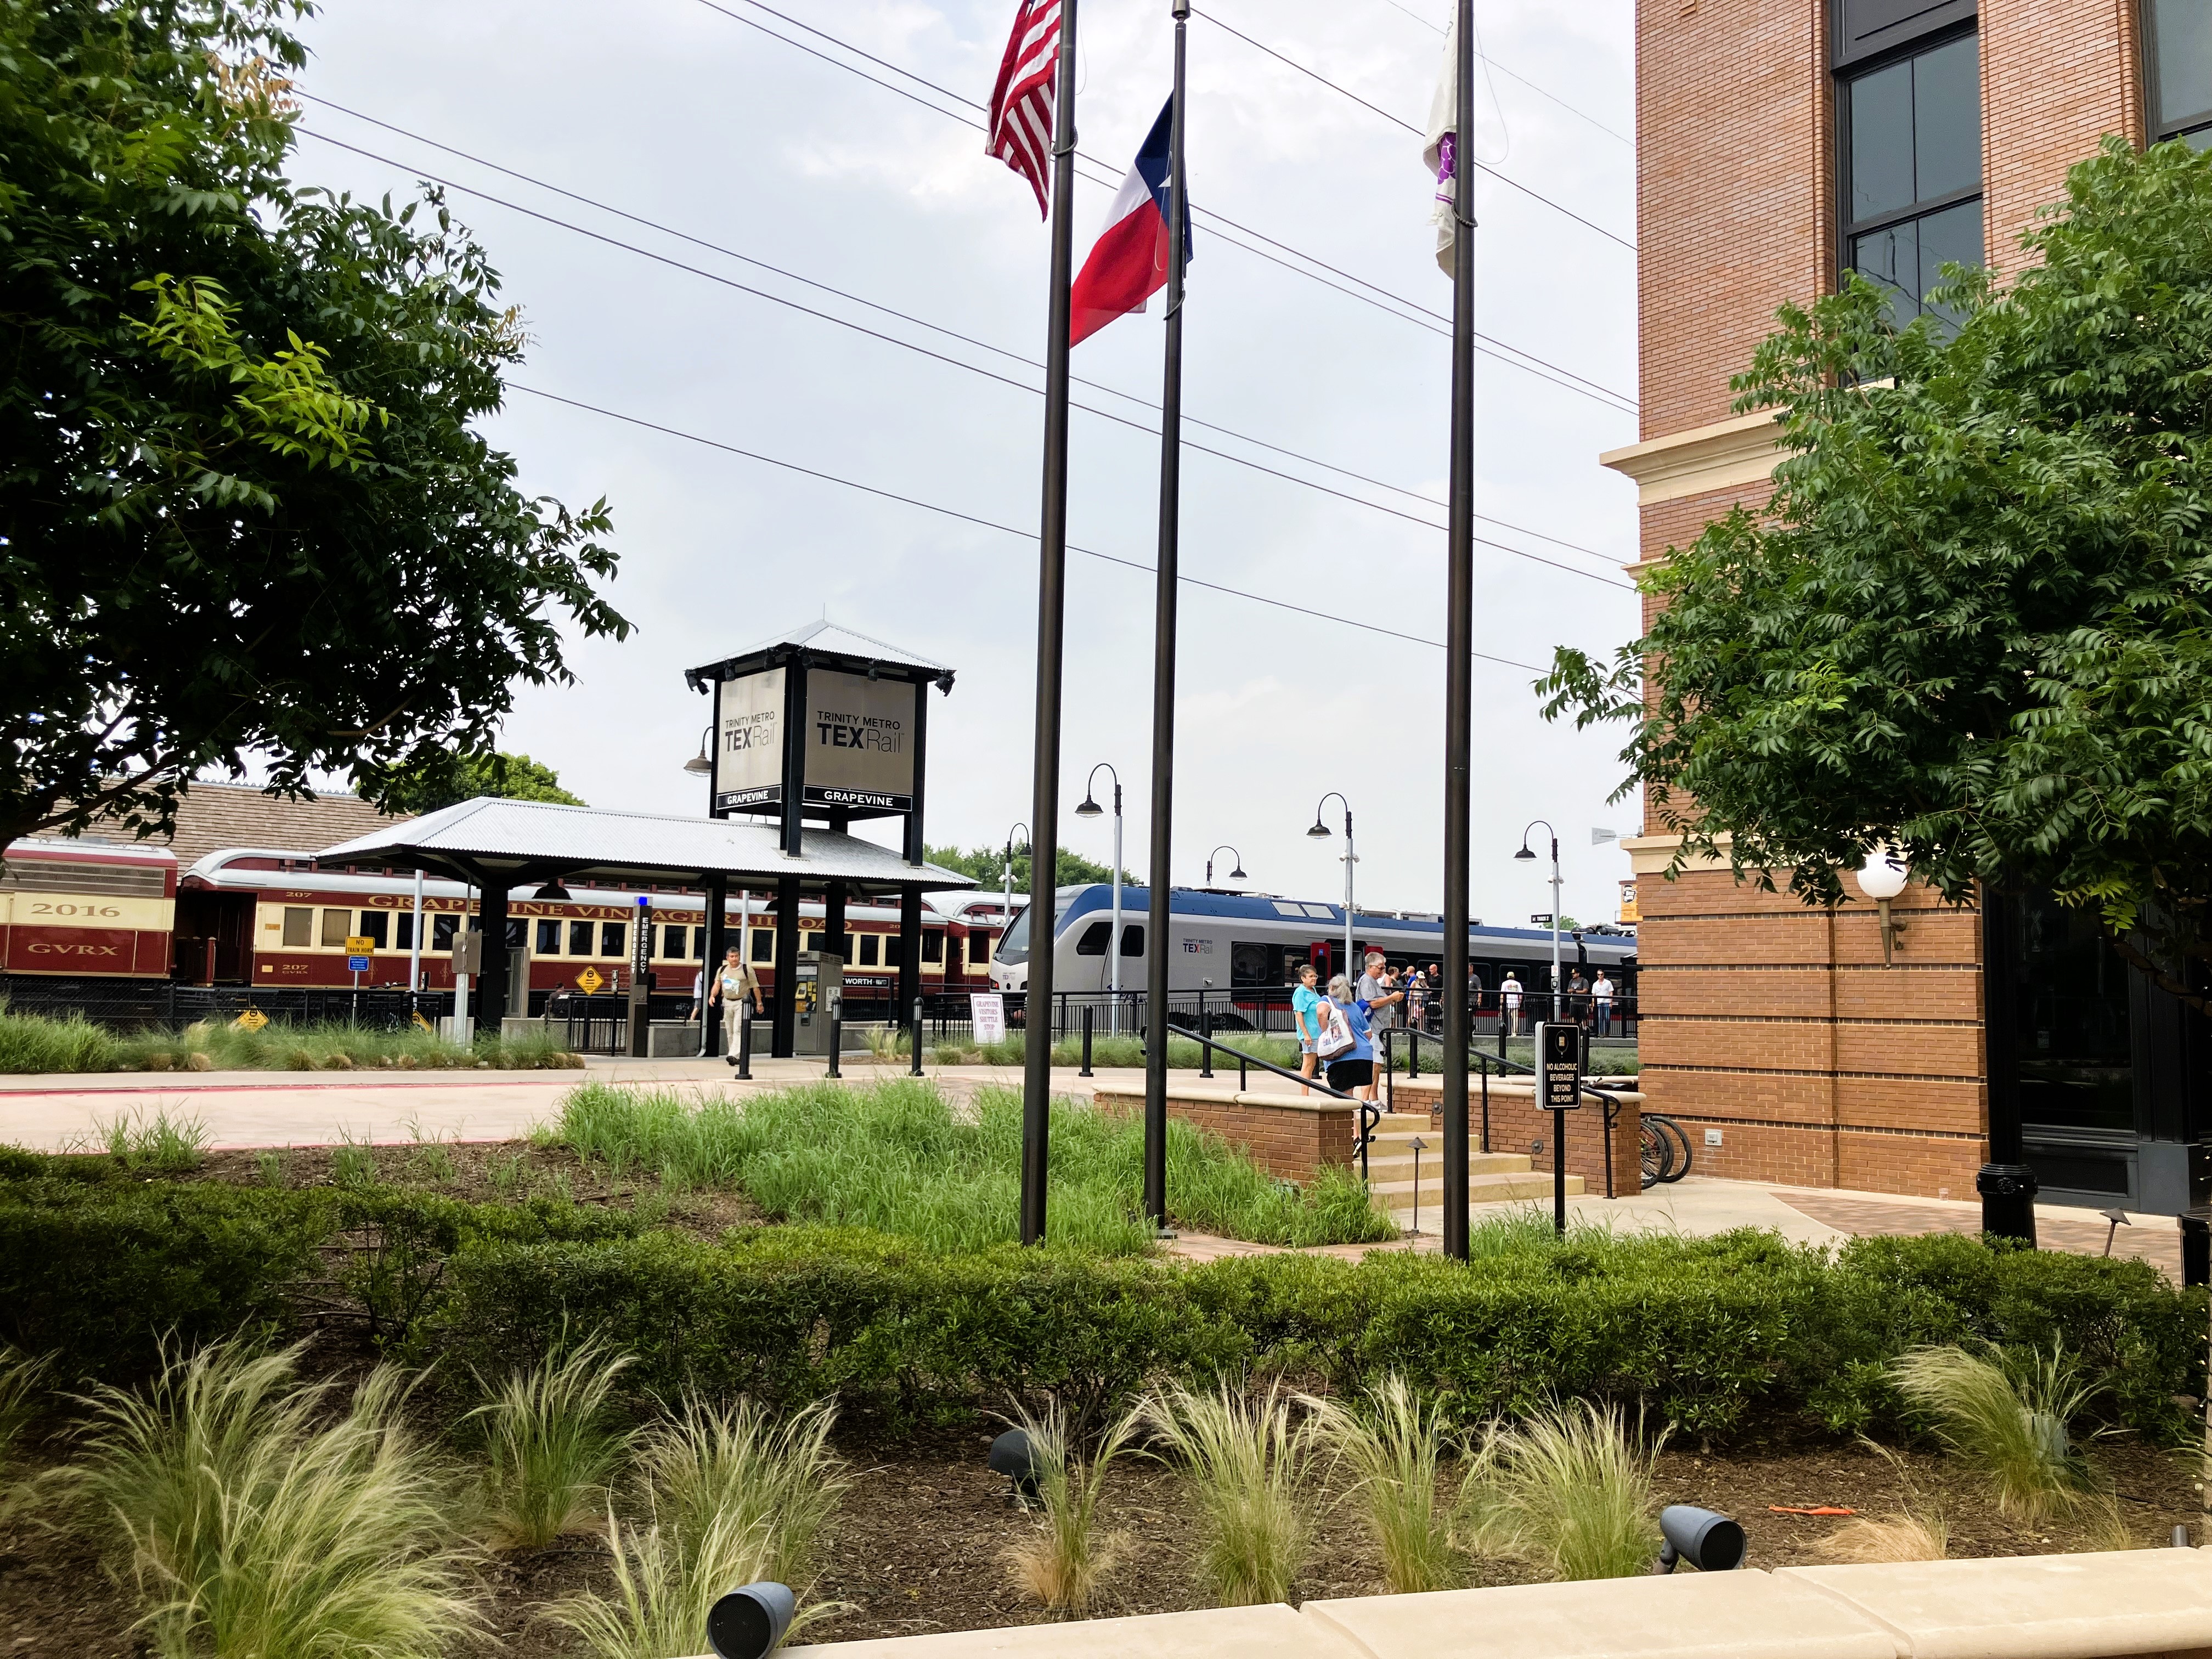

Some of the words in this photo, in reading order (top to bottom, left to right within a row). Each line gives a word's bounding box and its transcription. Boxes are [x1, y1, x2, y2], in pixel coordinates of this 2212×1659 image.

[726, 715, 749, 729] TRINITY
[751, 711, 775, 724] METRO
[817, 710, 859, 725] TRINITY
[863, 716, 900, 730] METRO
[727, 791, 769, 805] GRAPEVINE
[824, 791, 893, 806] GRAPEVINE
[31, 903, 120, 917] 2016
[368, 895, 564, 916] GRAPEINE
[576, 906, 704, 923] VINAGE
[28, 944, 119, 956] GVRX
[640, 917, 649, 974] EMERGENCY
[1561, 1094, 1573, 1103] POINT
